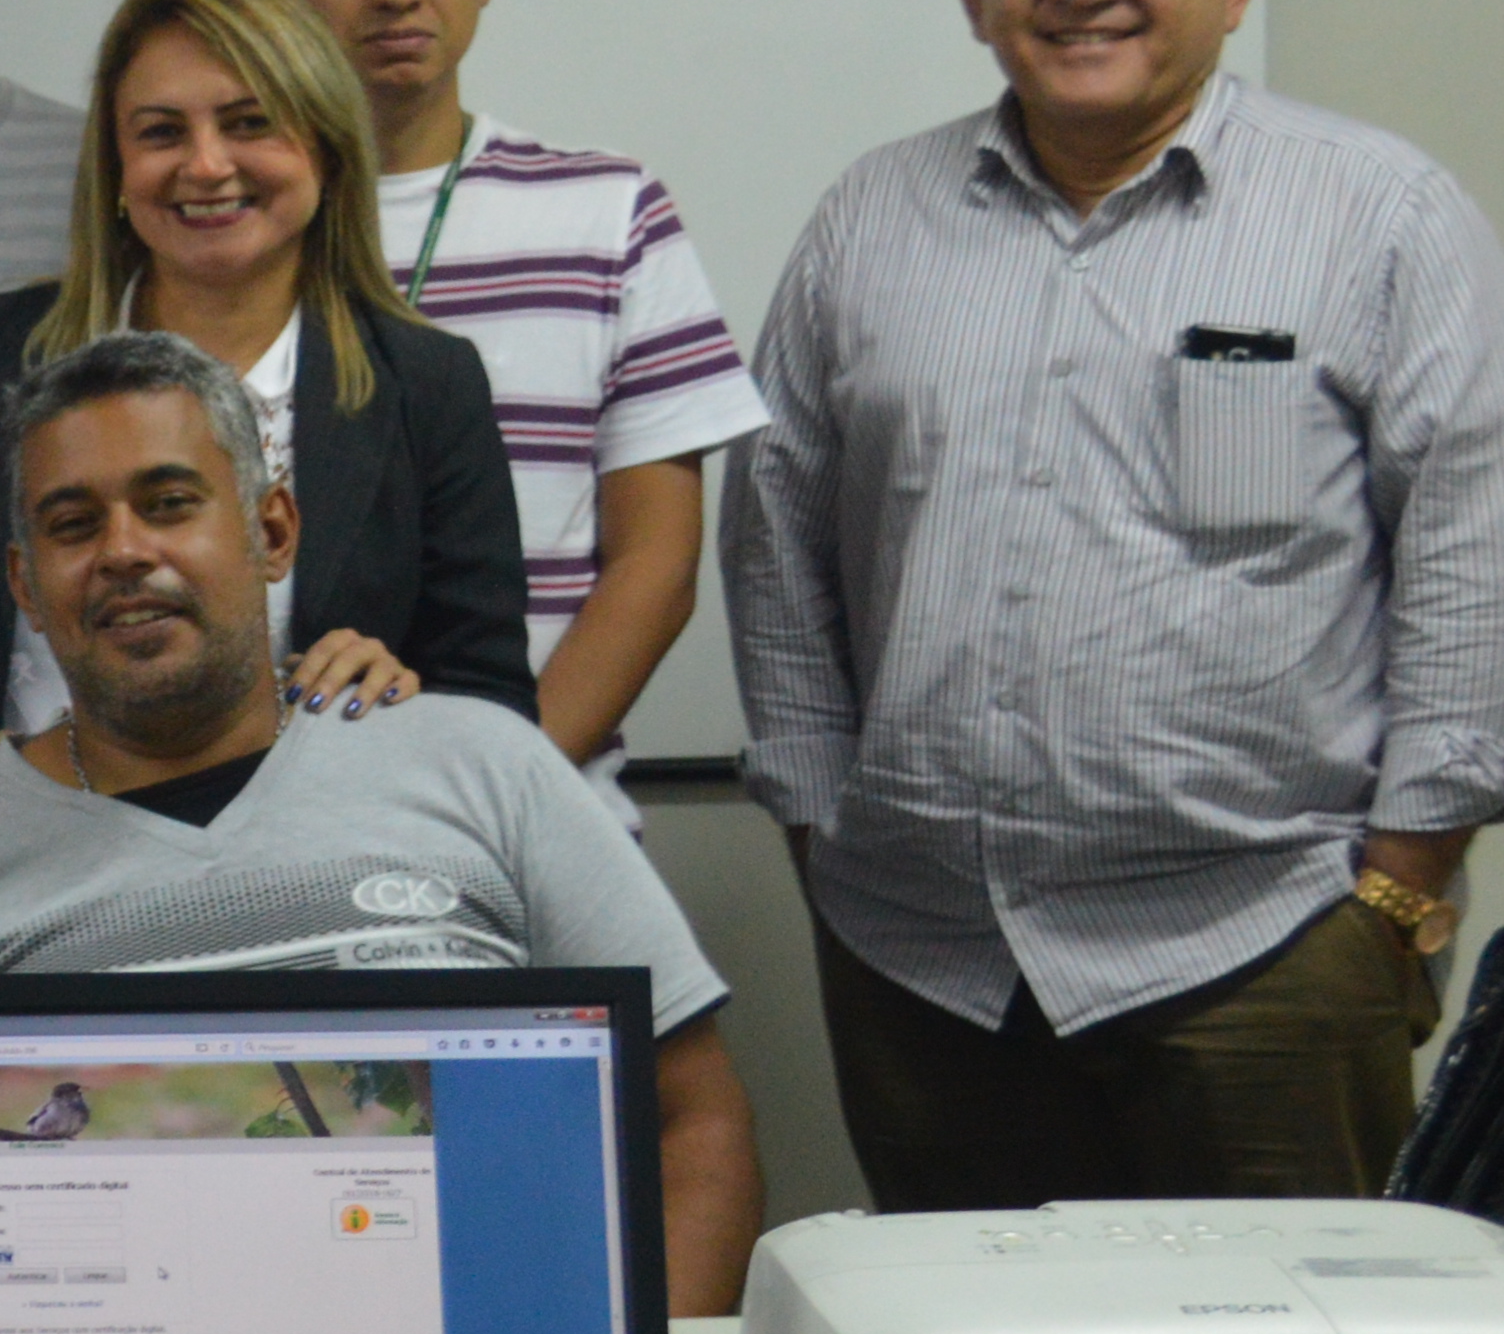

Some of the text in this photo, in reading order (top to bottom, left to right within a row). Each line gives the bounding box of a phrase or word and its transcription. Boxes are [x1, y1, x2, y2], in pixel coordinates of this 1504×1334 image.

[376, 880, 435, 912] CK
[352, 941, 421, 963] Calvin
[1179, 1303, 1291, 1316] EPSON
